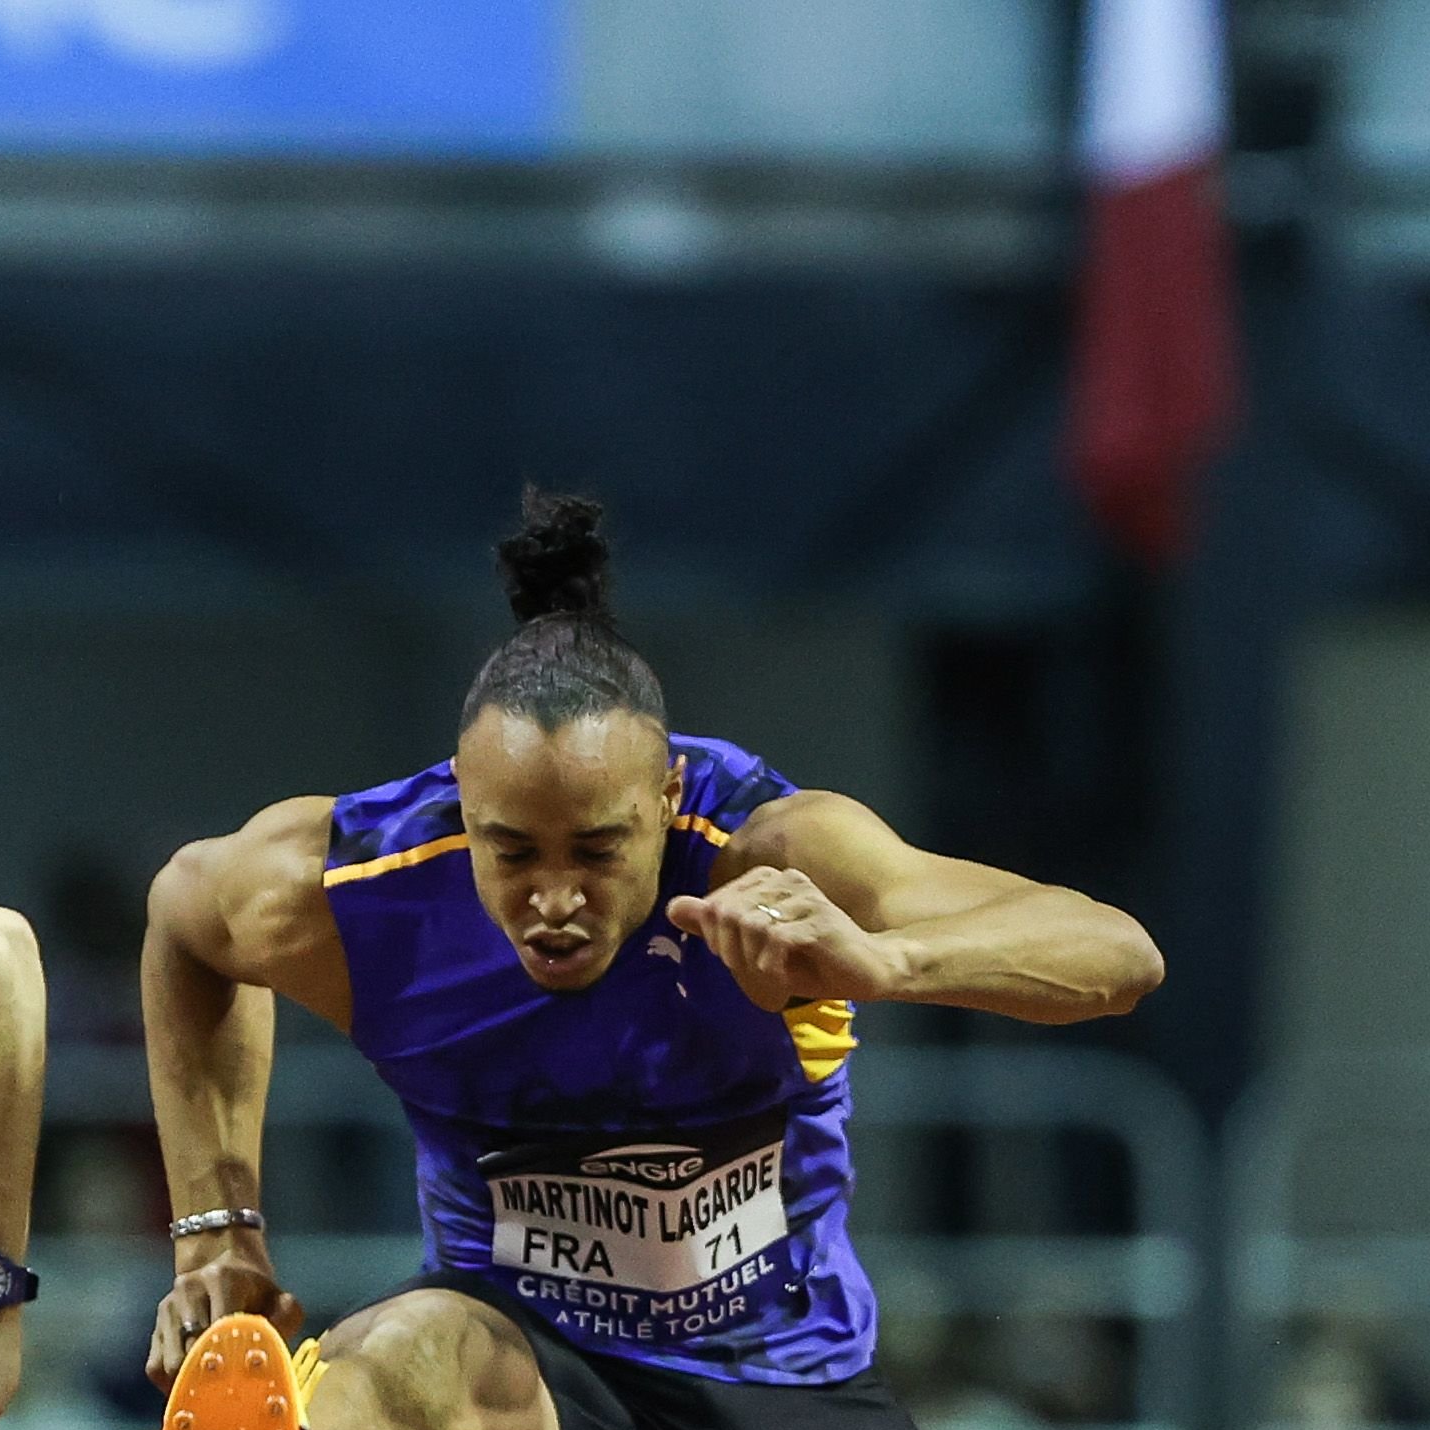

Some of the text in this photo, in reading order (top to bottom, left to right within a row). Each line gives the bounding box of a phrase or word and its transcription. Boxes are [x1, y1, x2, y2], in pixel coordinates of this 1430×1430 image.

[500, 1152, 774, 1243] MARTINOT LAGARDE
[522, 1227, 614, 1278] FRA
[705, 1222, 742, 1271] 71
[516, 1254, 775, 1316] CRÉDIT MUTUEL
[556, 1296, 746, 1339] ATHLÉ TOUR
